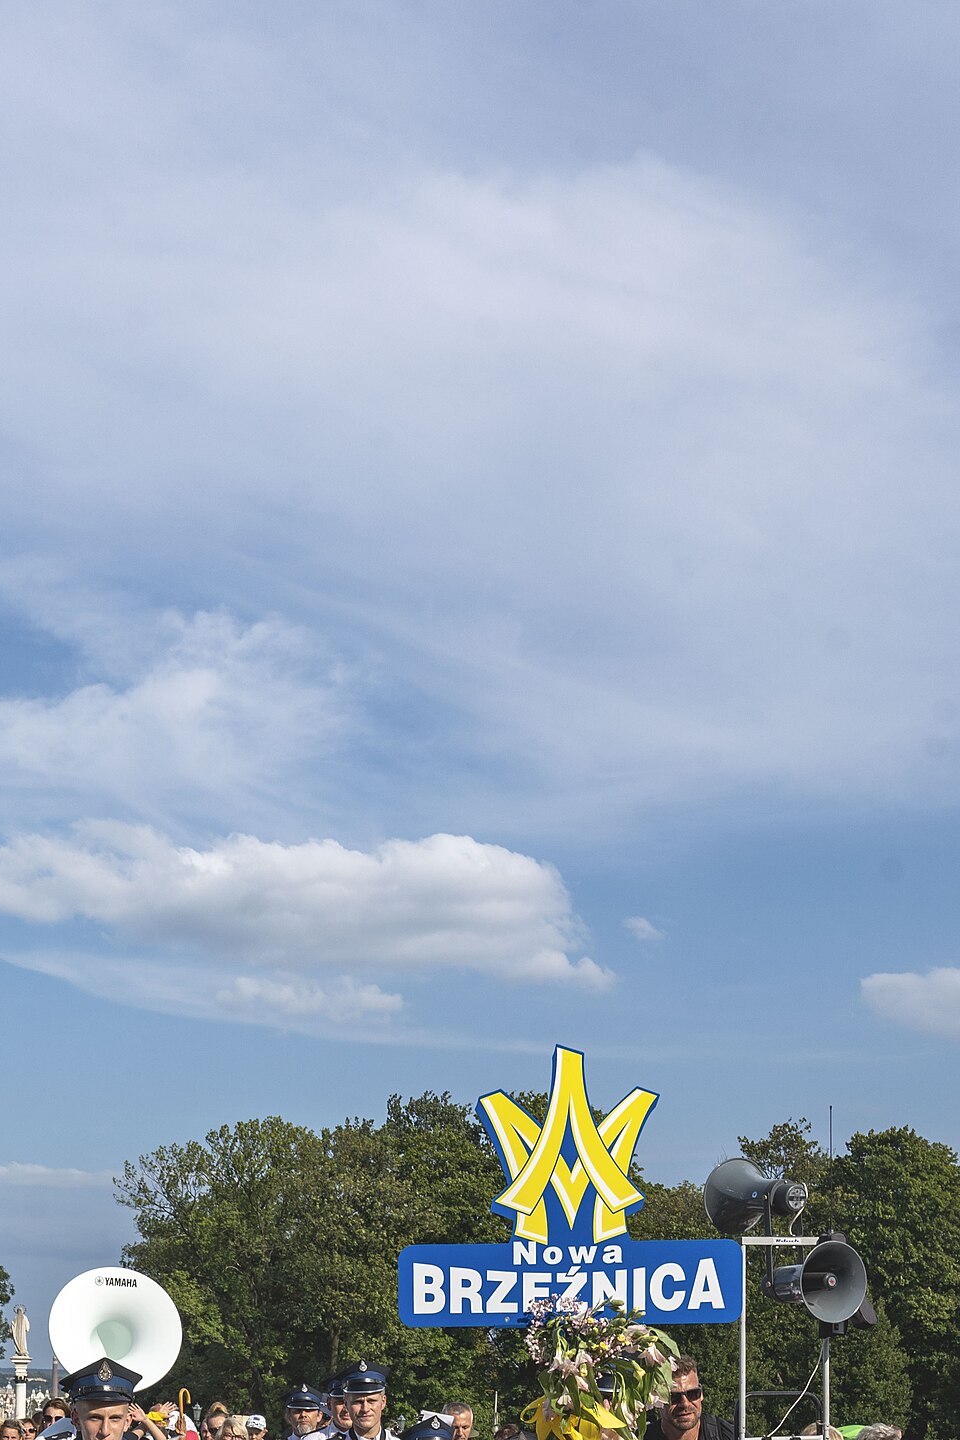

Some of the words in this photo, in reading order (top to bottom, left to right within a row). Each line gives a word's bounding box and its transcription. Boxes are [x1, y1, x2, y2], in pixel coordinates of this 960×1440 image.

[513, 1241, 623, 1265] Nowa
[105, 1277, 137, 1288] YAMAHA
[413, 1258, 726, 1315] BRZEŹNICA
